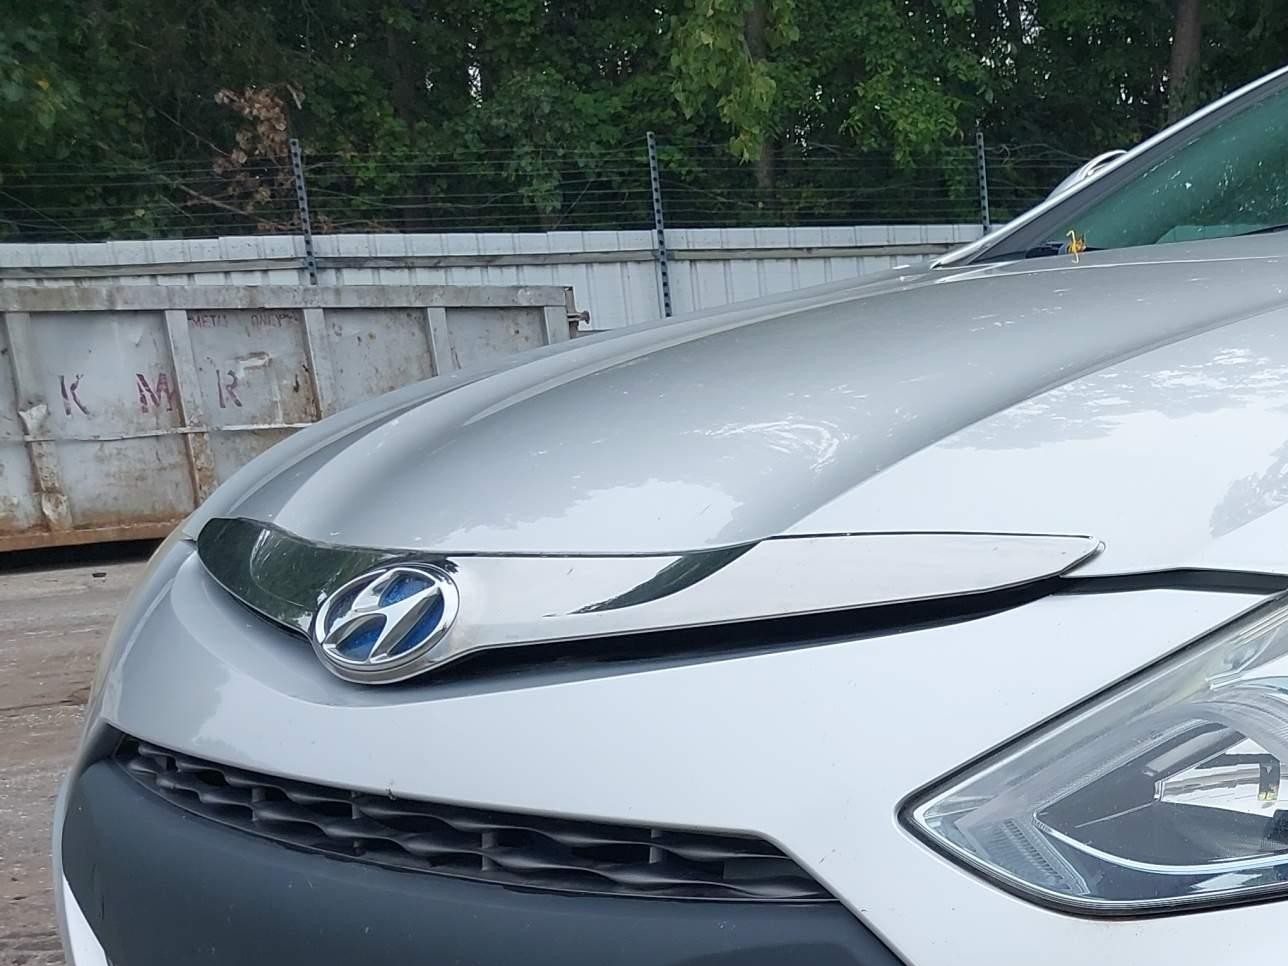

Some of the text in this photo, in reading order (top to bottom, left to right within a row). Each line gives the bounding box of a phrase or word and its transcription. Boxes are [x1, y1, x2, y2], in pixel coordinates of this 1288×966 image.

[59, 369, 243, 416] K M R
